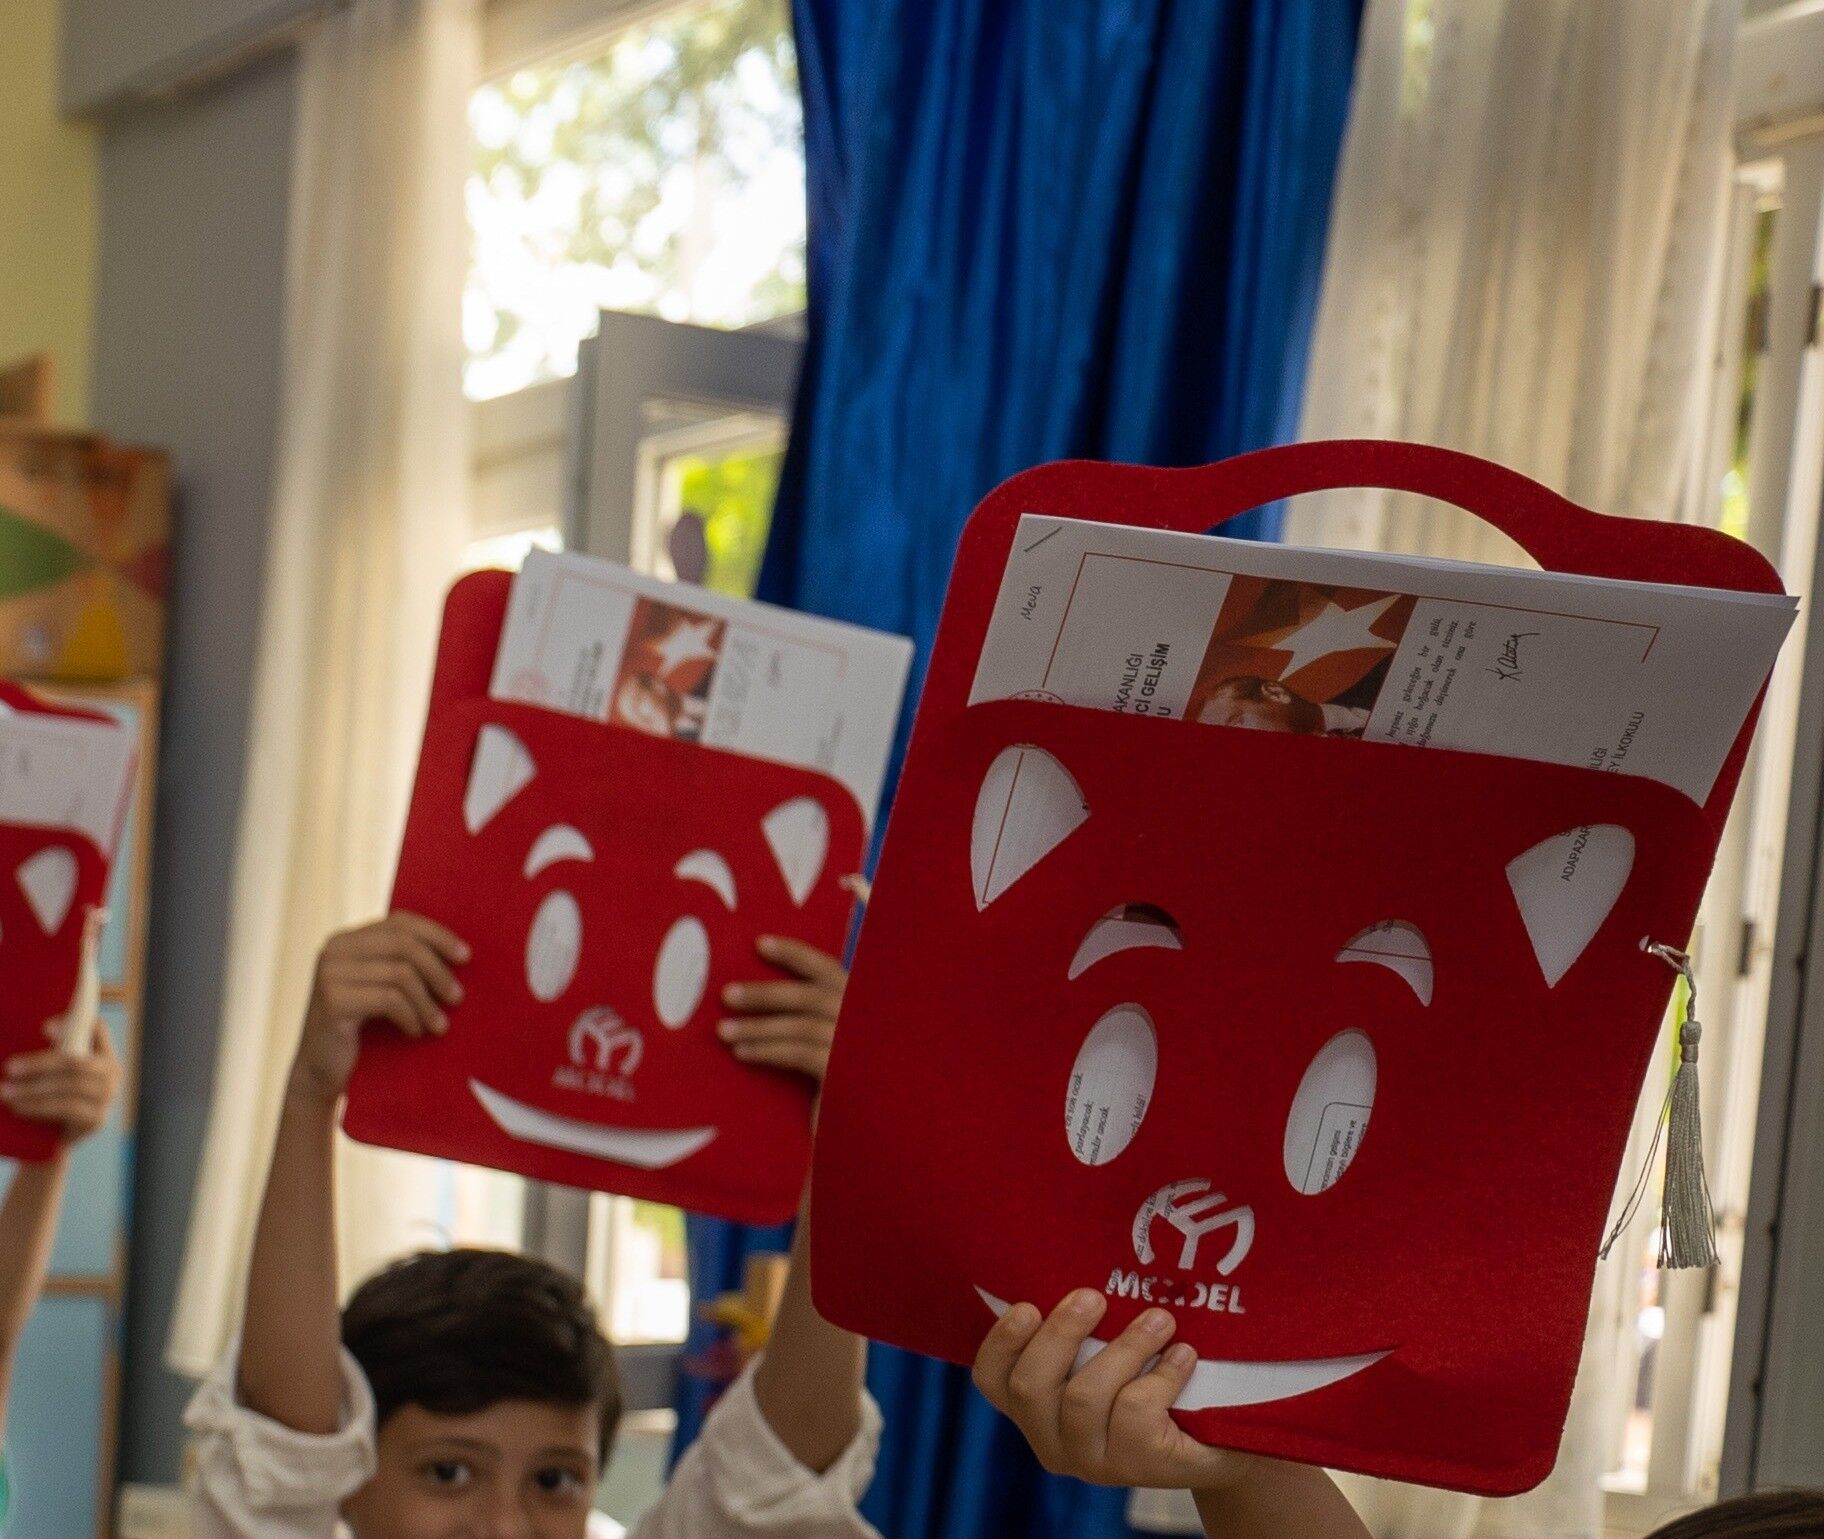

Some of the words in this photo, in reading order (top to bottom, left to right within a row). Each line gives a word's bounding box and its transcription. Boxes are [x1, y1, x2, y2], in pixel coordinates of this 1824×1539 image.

[1113, 653, 1144, 713] AKANLIĞI
[1141, 643, 1171, 700] GELİŞİM
[1431, 655, 1444, 673] olan
[1610, 711, 1645, 761] İLKOKULU
